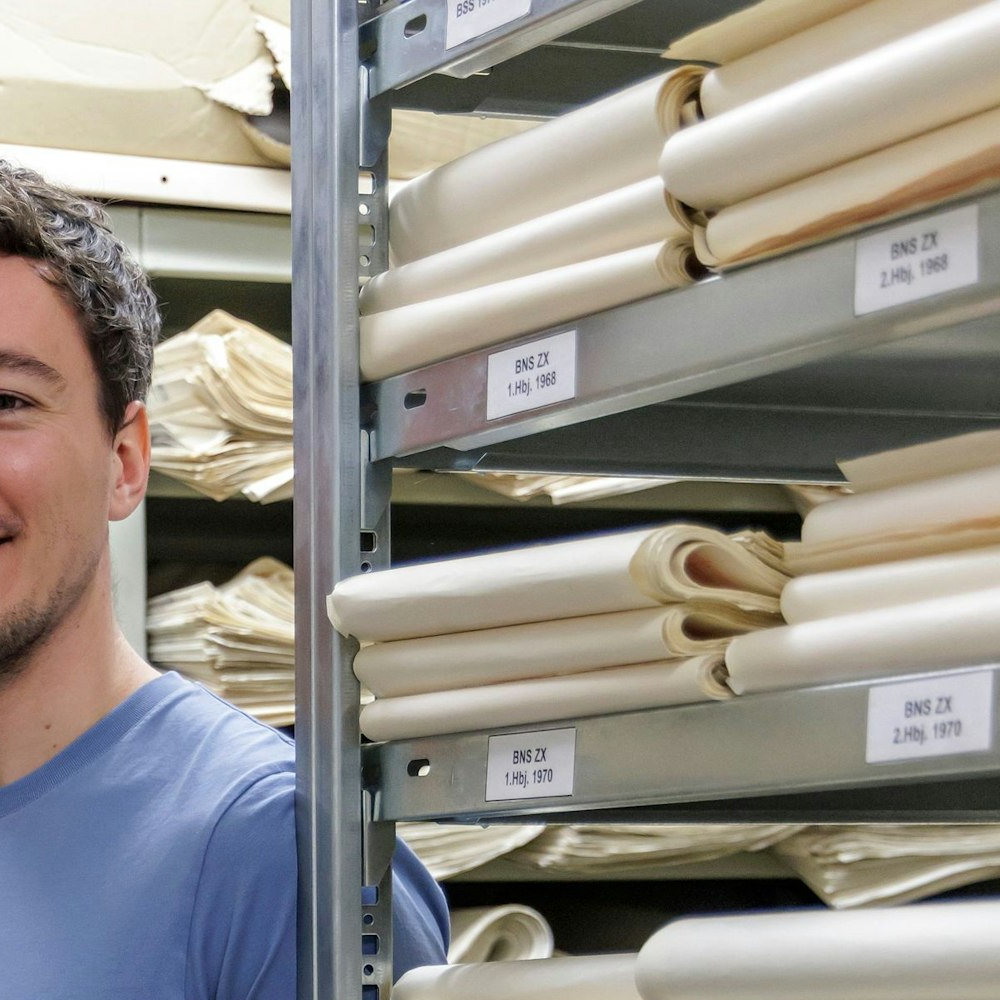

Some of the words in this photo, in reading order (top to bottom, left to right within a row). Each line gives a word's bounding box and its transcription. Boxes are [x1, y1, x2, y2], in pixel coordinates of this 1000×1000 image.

[456, 0, 475, 18] BSS
[890, 237, 918, 261] BNS
[921, 230, 939, 252] ZX
[920, 253, 949, 277] 1968
[515, 355, 535, 375] BNS
[536, 351, 550, 369] ZX
[507, 377, 533, 397] 1.Hbj.
[535, 370, 557, 390] 1968
[904, 698, 932, 719] BNS
[934, 695, 953, 715] ZX
[892, 723, 929, 746] 2.Hbj.
[933, 719, 963, 740] 1970
[512, 749, 532, 765] BNS
[533, 747, 547, 763] ZX
[504, 770, 530, 789] 1.Hbj.
[532, 768, 554, 784] 1970
